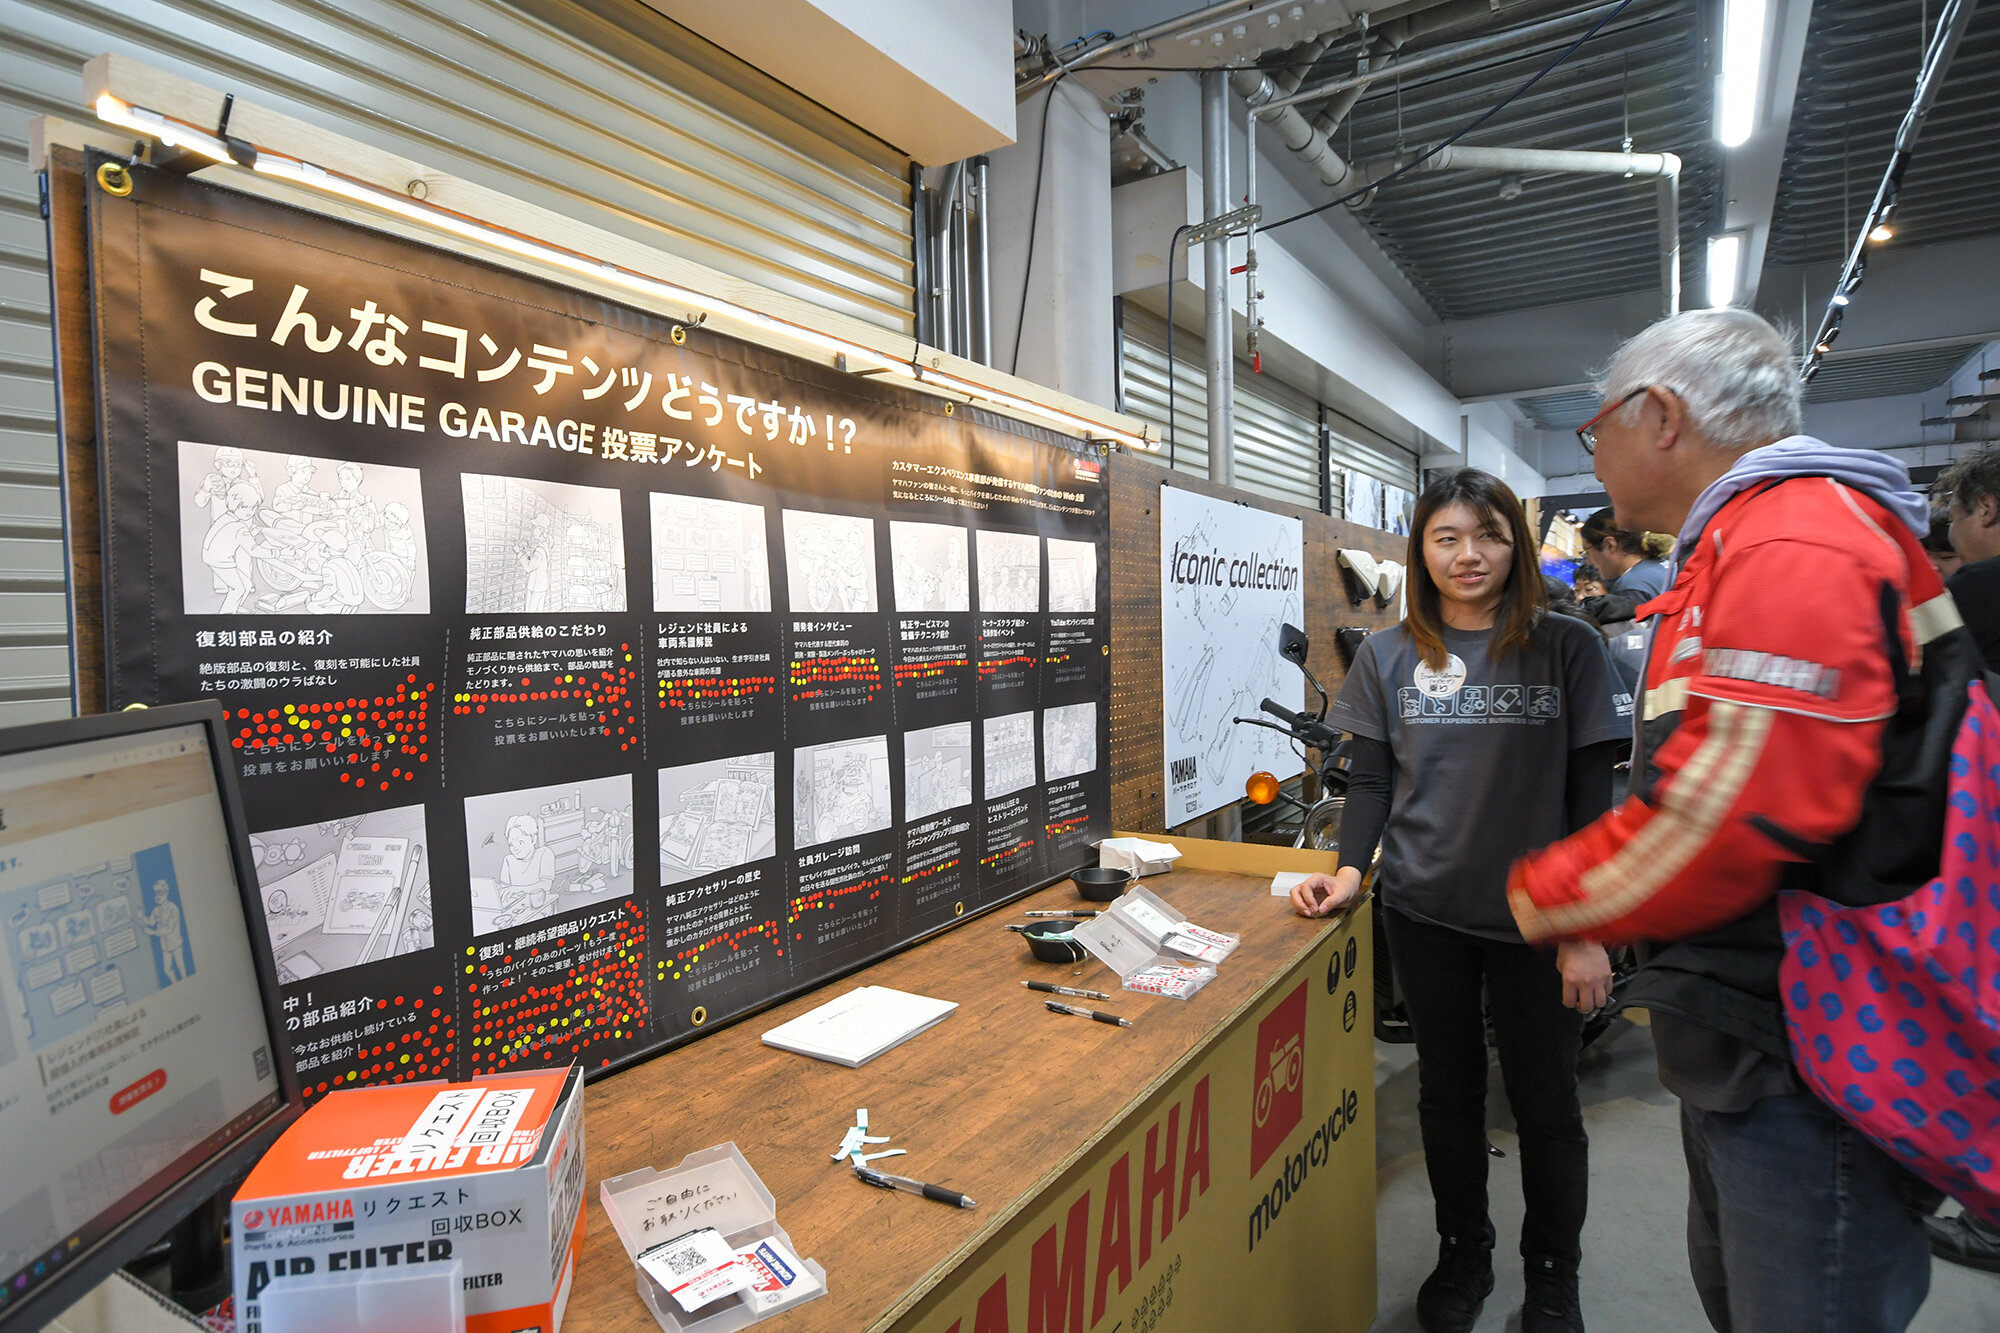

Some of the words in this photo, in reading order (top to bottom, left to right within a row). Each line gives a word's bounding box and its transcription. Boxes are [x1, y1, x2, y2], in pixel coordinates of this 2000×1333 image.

[191, 361, 425, 433] GENUINE
[438, 402, 596, 455] GARAGE
[601, 427, 762, 479] 投票アンケート
[1170, 542, 1226, 587] Iconic
[1229, 551, 1298, 592] collection
[469, 624, 607, 641] 純正部品供給のこだわり
[658, 622, 748, 634] レジェンド社員による
[793, 622, 852, 632] 開発者インタビュー
[900, 620, 949, 629] 純正サービスマンの
[900, 630, 950, 641] 整備テクニック紹介
[196, 629, 333, 648] 復刻部品の紹介
[658, 636, 713, 649] 車両系譜解説
[199, 655, 420, 675] 絶版部品の復刻と、復刻を可能にした社員
[467, 647, 614, 663] 純正部品に隠されたヤマハの思いを紹介
[657, 653, 770, 667] 社内で知らない人はいない、生き字引き社員
[466, 660, 614, 675] モノづくりから供給まで、部品の軌跡を
[657, 667, 721, 678] が語る意外な車両の系譜
[200, 675, 338, 692] たちの激闘のウラばなし
[466, 678, 513, 690] たどります。
[680, 709, 754, 726] 投票をお願いいたします
[1405, 717, 1440, 725] CUSTOMER
[1441, 717, 1487, 725] EXPERIENCE
[1489, 717, 1527, 725] BUSINESS
[1528, 718, 1547, 726] UNIT
[494, 726, 606, 746] 投票をお願いいたします
[1170, 756, 1197, 786] YAMAHA
[798, 844, 860, 868] 社員ガレージ訪問
[666, 870, 761, 907] 純正アクセサリーの歴史
[666, 889, 760, 924] ヤマハ純正アクセサリーはどのように
[479, 908, 626, 961] 復刻・継続希望部品リクエスト
[666, 914, 753, 948] 懐かしのカタログを振り返ります。
[688, 945, 759, 978] こちらにシールを貼って
[687, 958, 761, 993] 投票をお願いいたします
[286, 996, 374, 1031] の部品紹介
[409, 1091, 470, 1154] リクエスト
[469, 1090, 522, 1144] 回収BOX
[1248, 1089, 1359, 1254] motorcycle
[267, 1199, 355, 1228] YAMAHA
[363, 1188, 470, 1217] リクエスト
[646, 1184, 711, 1212] ご自由に
[431, 1208, 523, 1237] 回収BOX
[642, 1192, 738, 1232] お取りください
[288, 1233, 355, 1247] Accessories
